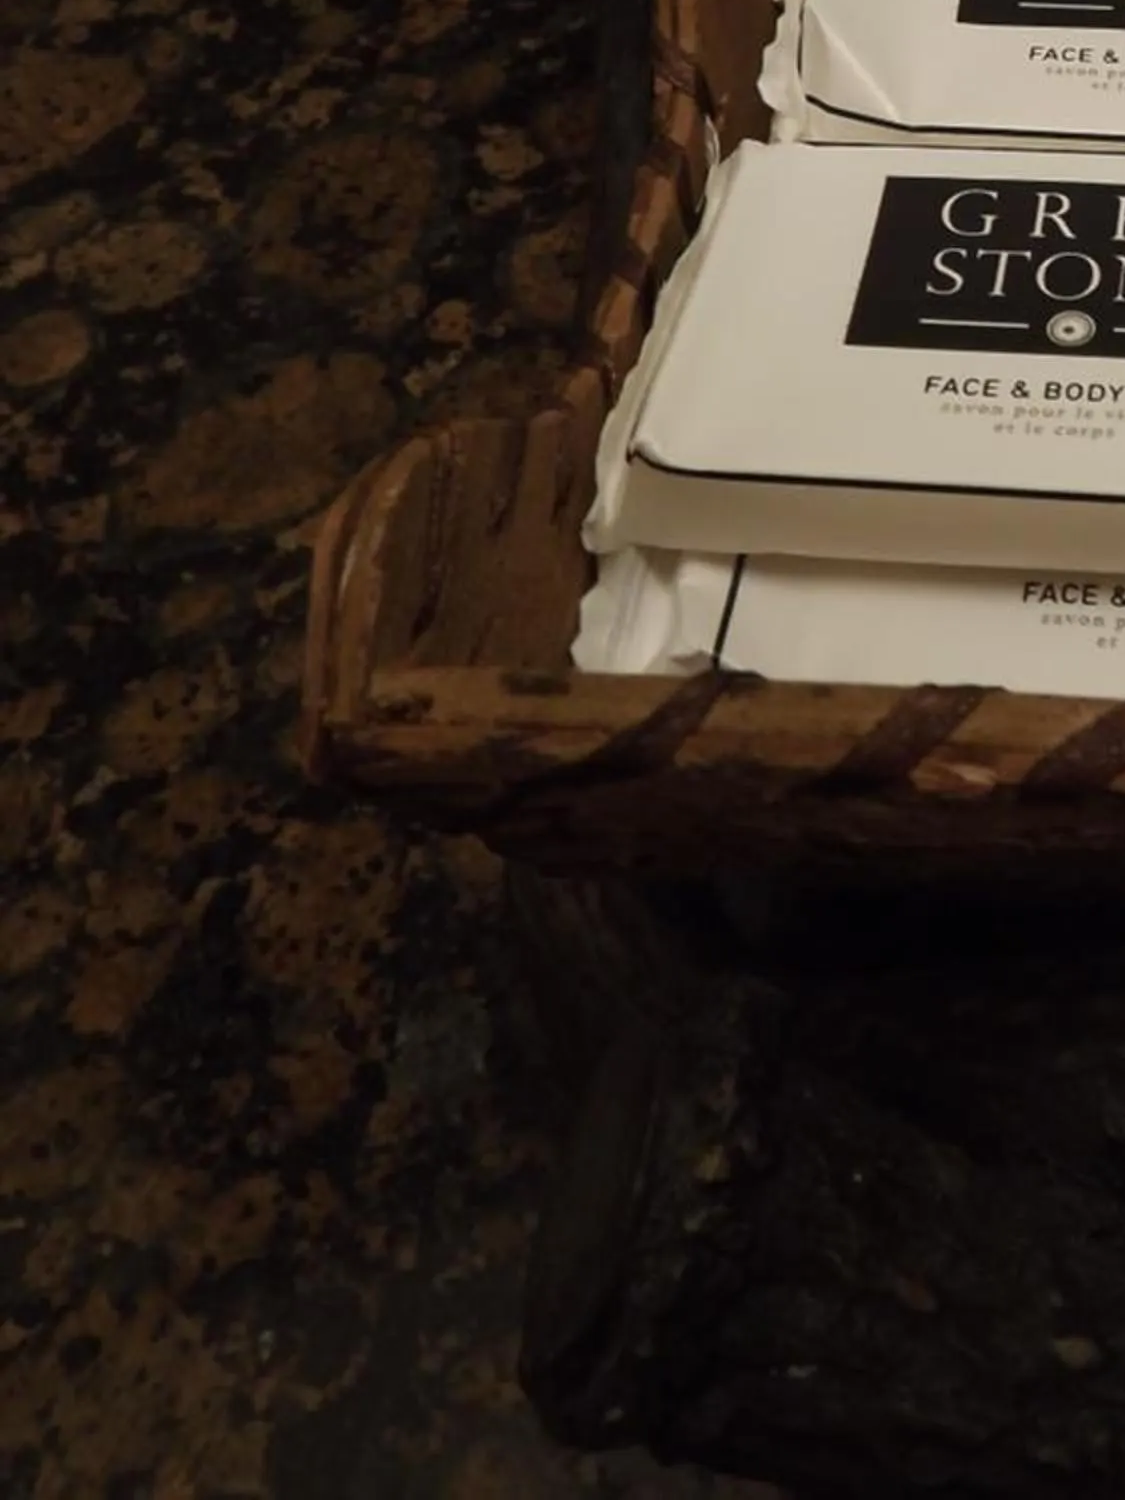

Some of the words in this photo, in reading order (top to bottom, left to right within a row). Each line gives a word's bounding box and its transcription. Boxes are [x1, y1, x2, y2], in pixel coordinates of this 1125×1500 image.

[1028, 46, 1095, 64] FACE
[1102, 49, 1120, 64] &
[924, 376, 1001, 398] FACE
[1010, 380, 1030, 399] &
[1044, 381, 1125, 403] BODY
[940, 402, 1005, 416] savon
[1012, 405, 1066, 420] pour
[1075, 407, 1094, 420] le
[1025, 422, 1044, 435] le
[1053, 425, 1116, 441] corps
[1022, 581, 1099, 607] FACE
[1040, 612, 1106, 627] savon
[1096, 635, 1118, 649] et
